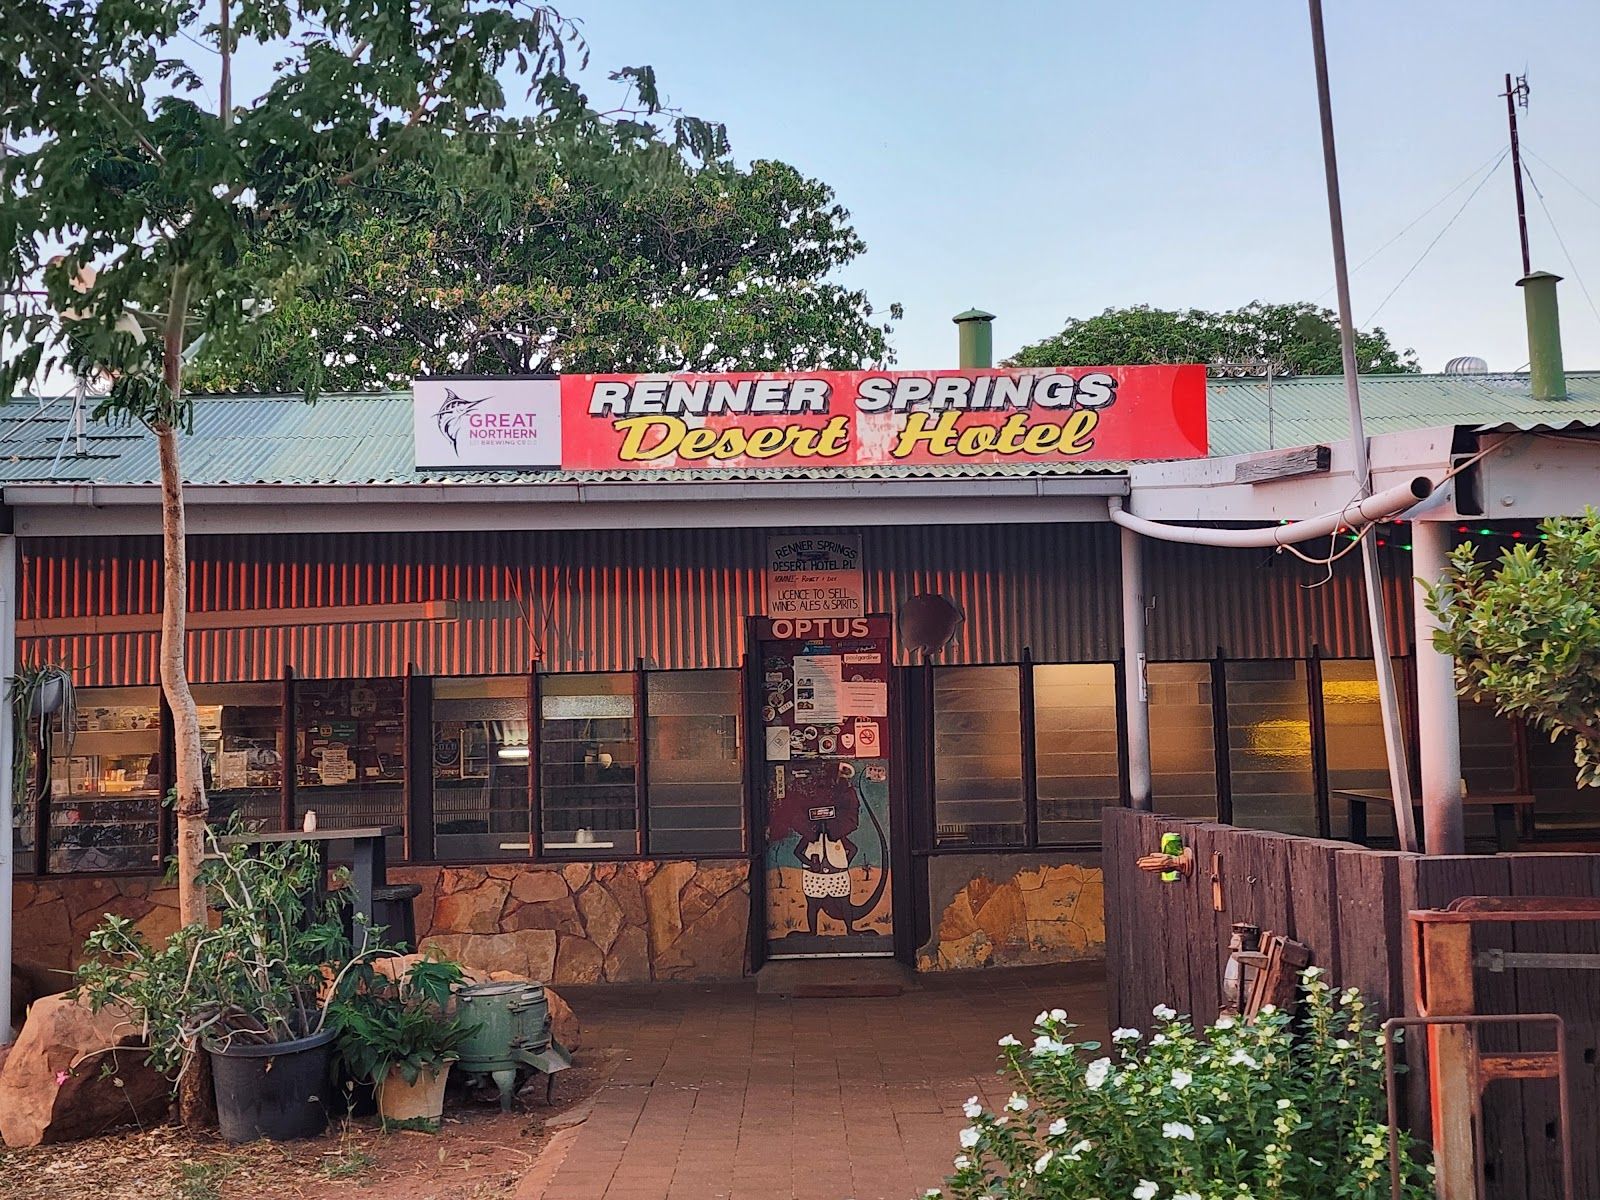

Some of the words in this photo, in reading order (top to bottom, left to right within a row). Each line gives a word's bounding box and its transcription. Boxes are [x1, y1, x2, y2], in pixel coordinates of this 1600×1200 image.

[587, 379, 832, 417] RENNER
[855, 373, 1118, 413] SPRINGS
[469, 413, 537, 428] GREAT
[469, 429, 537, 439] NORTHERN
[613, 414, 851, 461] Desert
[893, 409, 1100, 457] Hotel
[775, 540, 813, 559] RENNER
[817, 540, 857, 559] SPRINGS
[773, 561, 807, 572] DESERT
[811, 560, 839, 571] HOTEL
[777, 589, 810, 600] LICENCE
[813, 589, 825, 599] TO
[828, 587, 850, 599] SELL
[800, 600, 821, 611] ALES
[823, 600, 830, 610] &
[772, 618, 869, 639] OPTUS
